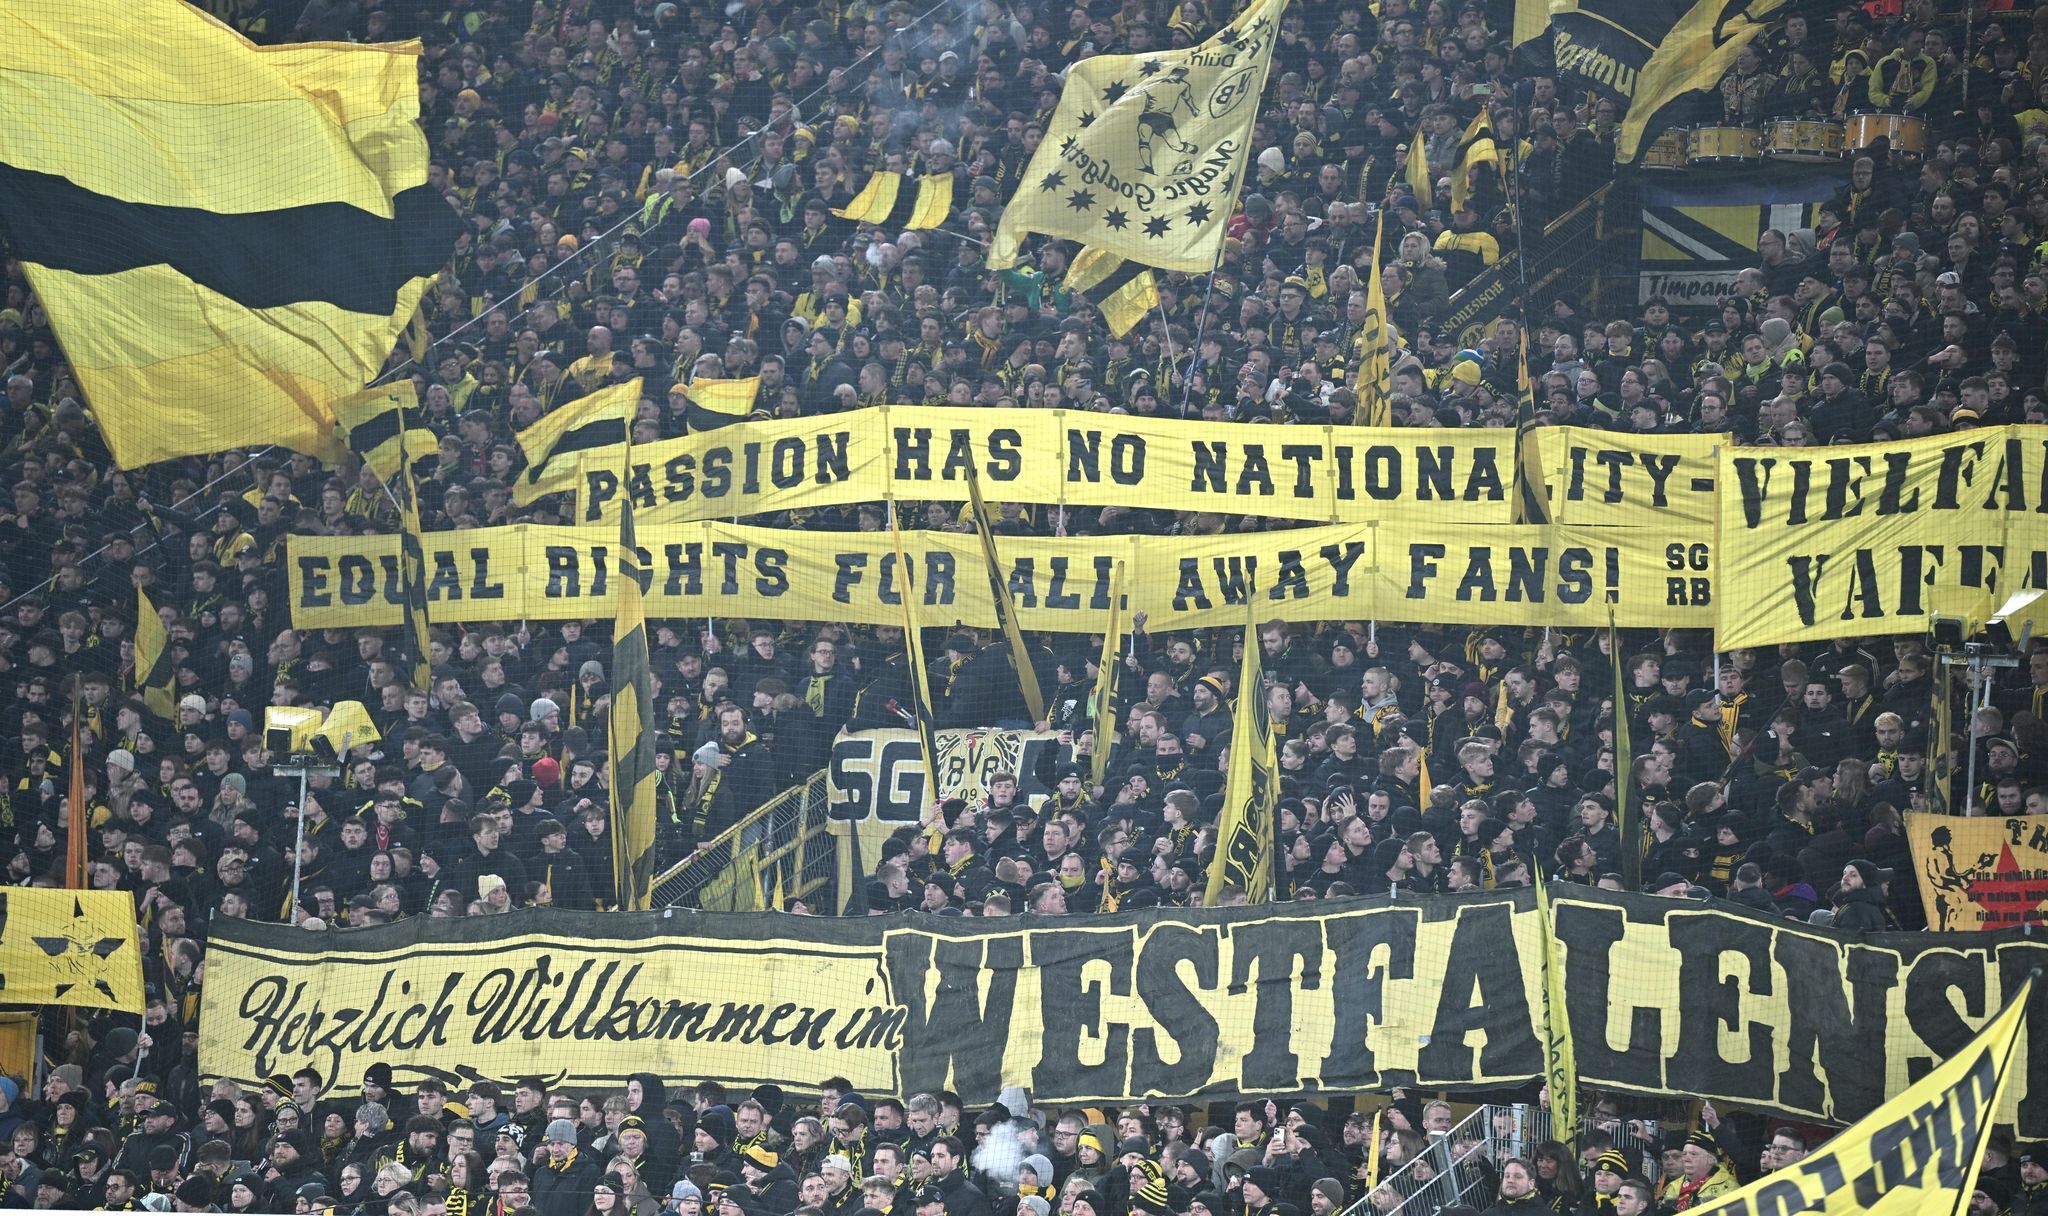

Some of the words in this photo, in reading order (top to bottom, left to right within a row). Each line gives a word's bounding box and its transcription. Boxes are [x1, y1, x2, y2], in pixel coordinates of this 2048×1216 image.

[586, 431, 850, 522] PASSION
[893, 427, 1022, 481] HAS
[1067, 429, 1146, 486] NO
[1191, 440, 1715, 507] NATIONAITY-
[832, 551, 955, 605] FOR
[1007, 555, 1128, 610] ALL
[1172, 541, 1366, 611] AWAY
[1405, 543, 1619, 605] FANS!
[1666, 542, 1710, 572] SG
[1666, 577, 1712, 607] RB
[830, 740, 927, 821] SG
[960, 788, 978, 801] 09
[240, 969, 464, 1098] Herzlich
[466, 954, 834, 1052] Willkommen
[834, 979, 906, 1052] im
